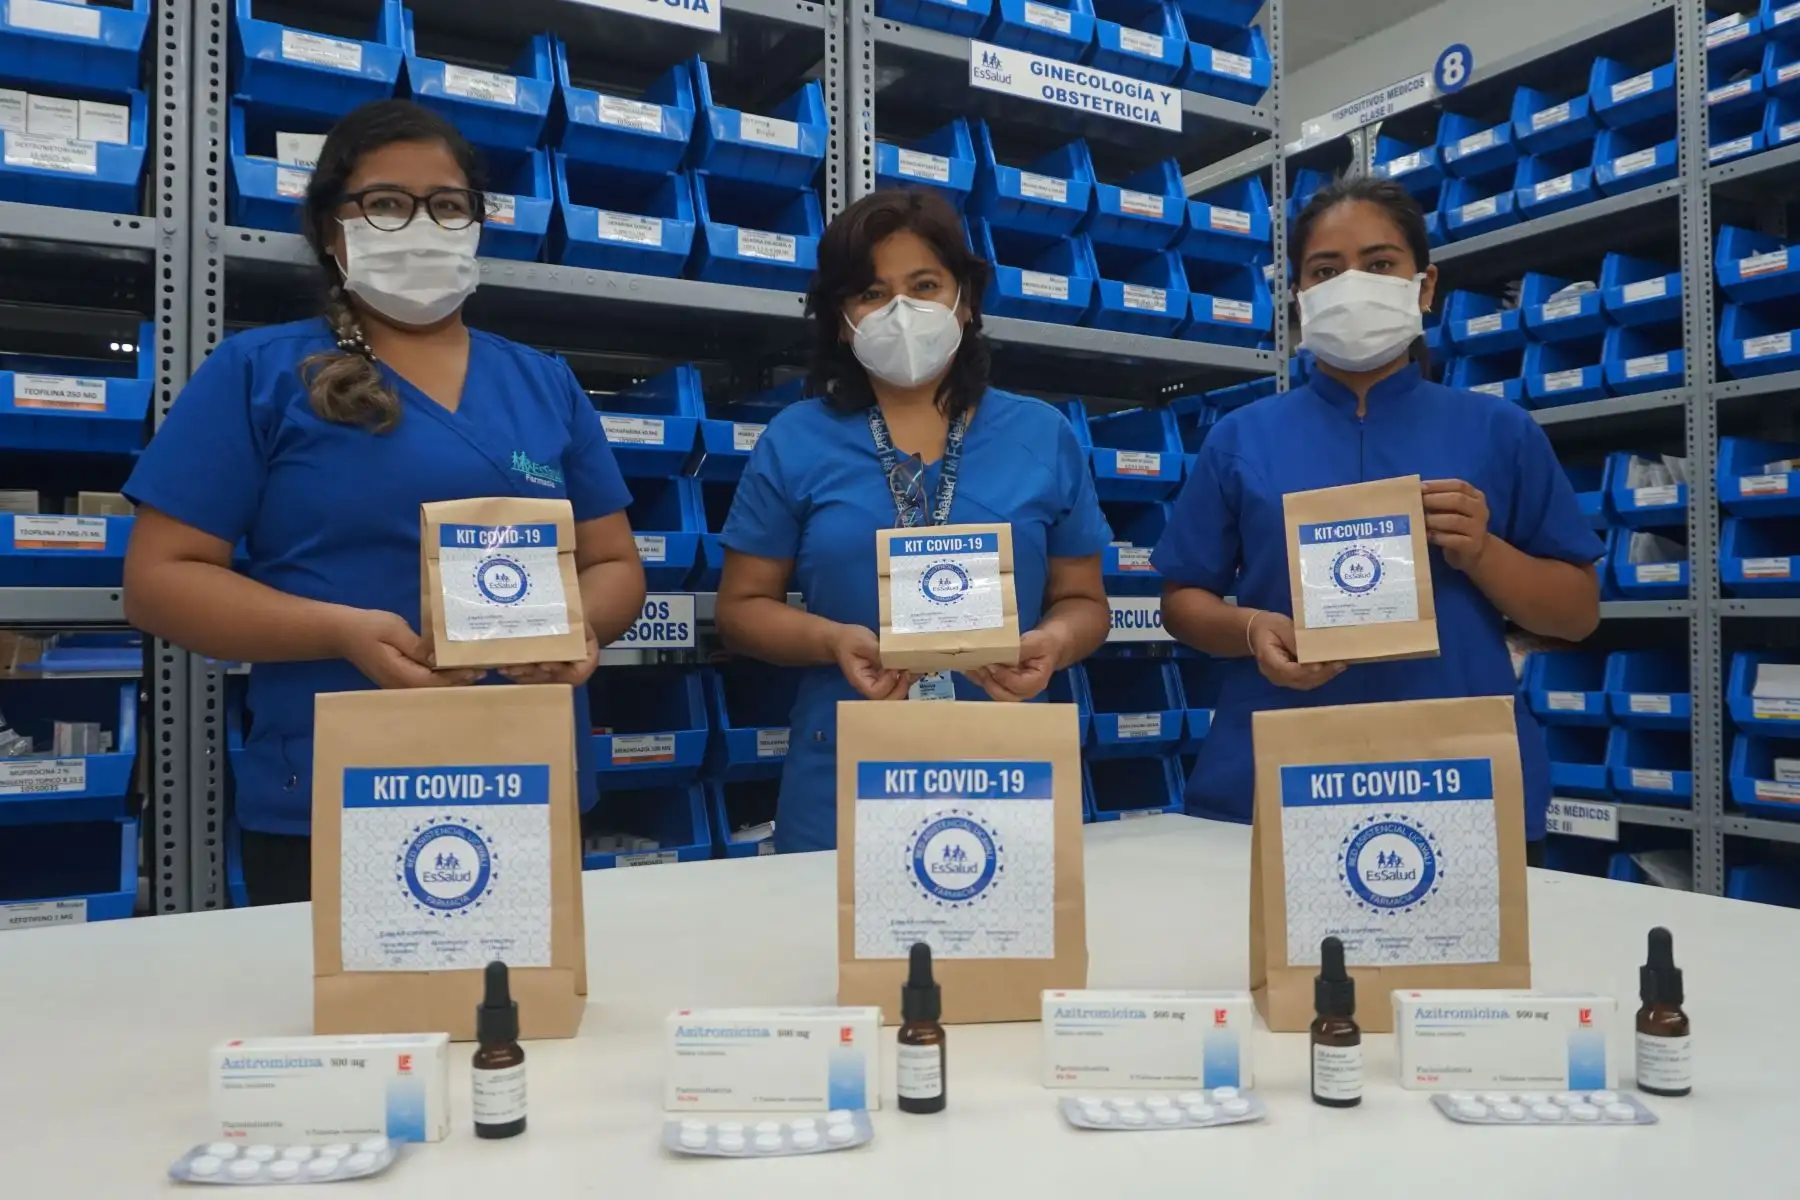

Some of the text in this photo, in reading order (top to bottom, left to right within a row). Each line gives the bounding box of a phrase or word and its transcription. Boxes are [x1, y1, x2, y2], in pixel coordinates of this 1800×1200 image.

[973, 67, 1012, 85] EsSalud
[1442, 51, 1465, 86] 8
[1030, 61, 1171, 105] GINECOLOGÍA Y
[1041, 85, 1162, 125] OBSTETRICIA
[1360, 106, 1386, 124] CLASE
[457, 529, 541, 545] KIT COVID-19
[1314, 520, 1394, 541] KIT COVID-19
[905, 538, 983, 553] KIT COVID-19
[640, 601, 670, 620] OS
[621, 622, 689, 641] SORES
[373, 773, 522, 800] KIT COVID-19
[885, 769, 1024, 793] KIT COVID-19
[1311, 768, 1461, 799] KIT COVID-19
[423, 870, 472, 883] EsSalud
[931, 862, 978, 874] EsSalud
[1366, 868, 1416, 882] EsSalud
[1054, 1007, 1147, 1020] Azitromicina
[1172, 1012, 1185, 1021] mg
[1415, 1007, 1510, 1020] Azitromicina
[1535, 1012, 1549, 1020] mg
[675, 1026, 770, 1038] Azitromicina
[796, 1031, 810, 1040] mg
[220, 1056, 323, 1070] Azitromicina
[351, 1058, 367, 1069] mg
